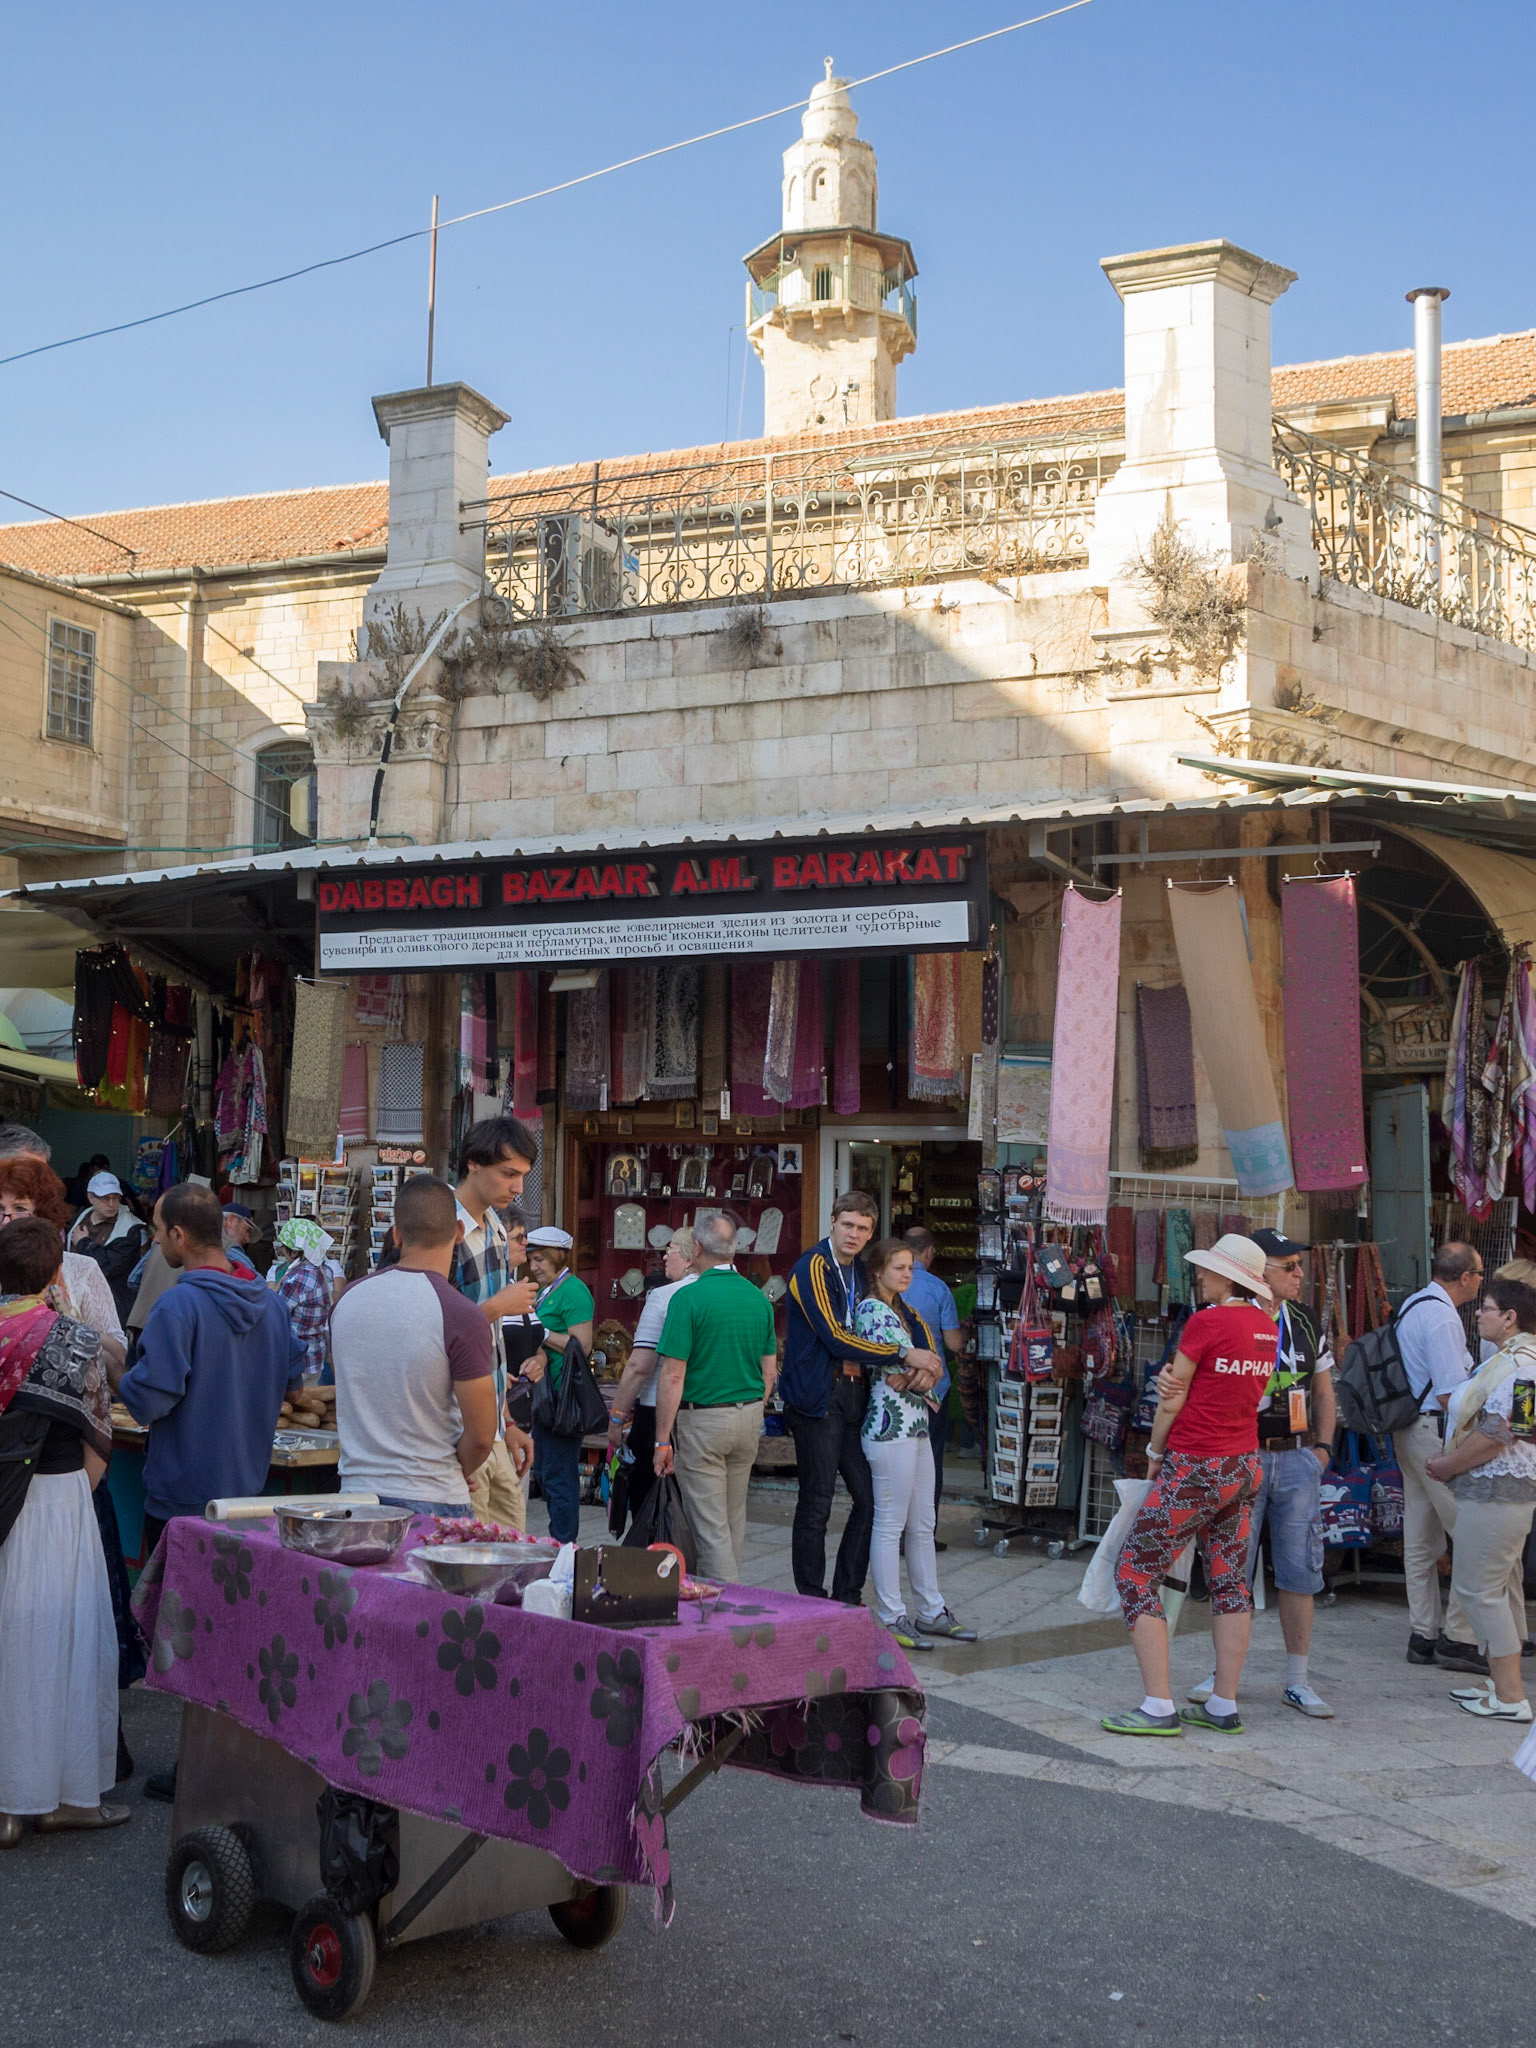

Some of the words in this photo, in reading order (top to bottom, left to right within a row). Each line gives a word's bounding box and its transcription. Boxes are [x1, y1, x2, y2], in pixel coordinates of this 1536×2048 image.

[319, 876, 480, 912] DABBAGH
[502, 863, 651, 903] BAZAAR
[671, 857, 753, 893] A.M.
[772, 847, 967, 888] BARAKAT
[322, 945, 377, 958] сувениры
[380, 945, 394, 954] из
[396, 942, 469, 954] оливкового
[471, 940, 513, 952] дерева
[516, 940, 524, 948] и
[527, 936, 608, 950] перламутра,
[609, 932, 668, 943] именные
[773, 924, 848, 937] целителеи
[855, 919, 942, 935] чудотврные
[359, 934, 429, 946] Предлагает
[532, 923, 621, 940] ерусалимские
[720, 917, 766, 929] зделия
[770, 916, 786, 926] из
[792, 914, 838, 924] золота
[842, 913, 851, 922] и
[855, 908, 919, 924] серебра,
[496, 950, 519, 961] для
[524, 945, 610, 958] молитвенных
[616, 942, 662, 956] просьб
[666, 943, 674, 952] и
[1214, 1357, 1275, 1377] БАРНАУ
